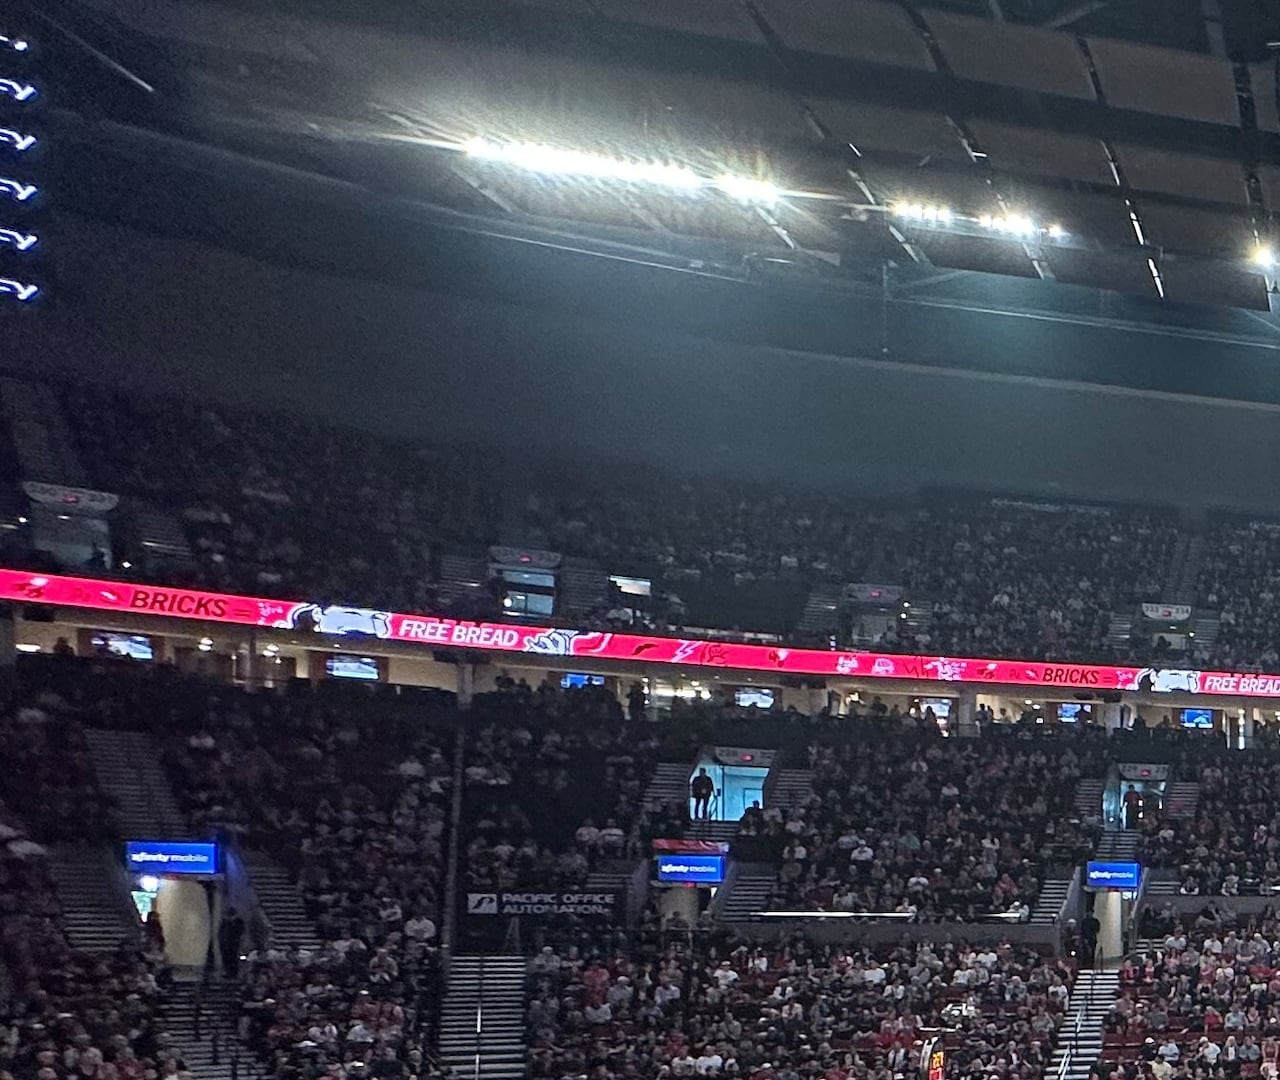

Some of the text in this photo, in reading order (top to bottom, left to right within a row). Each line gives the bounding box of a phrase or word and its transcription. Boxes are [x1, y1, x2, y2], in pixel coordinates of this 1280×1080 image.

[130, 590, 228, 617] BRICKS
[400, 619, 518, 648] FREE BREAD
[1043, 668, 1099, 685] BRICKS
[1204, 677, 1237, 692] FREE
[131, 851, 209, 863] xfinity mobile
[502, 893, 615, 904] PACIFIC OFFICE
[503, 904, 603, 915] AUTOMATION
